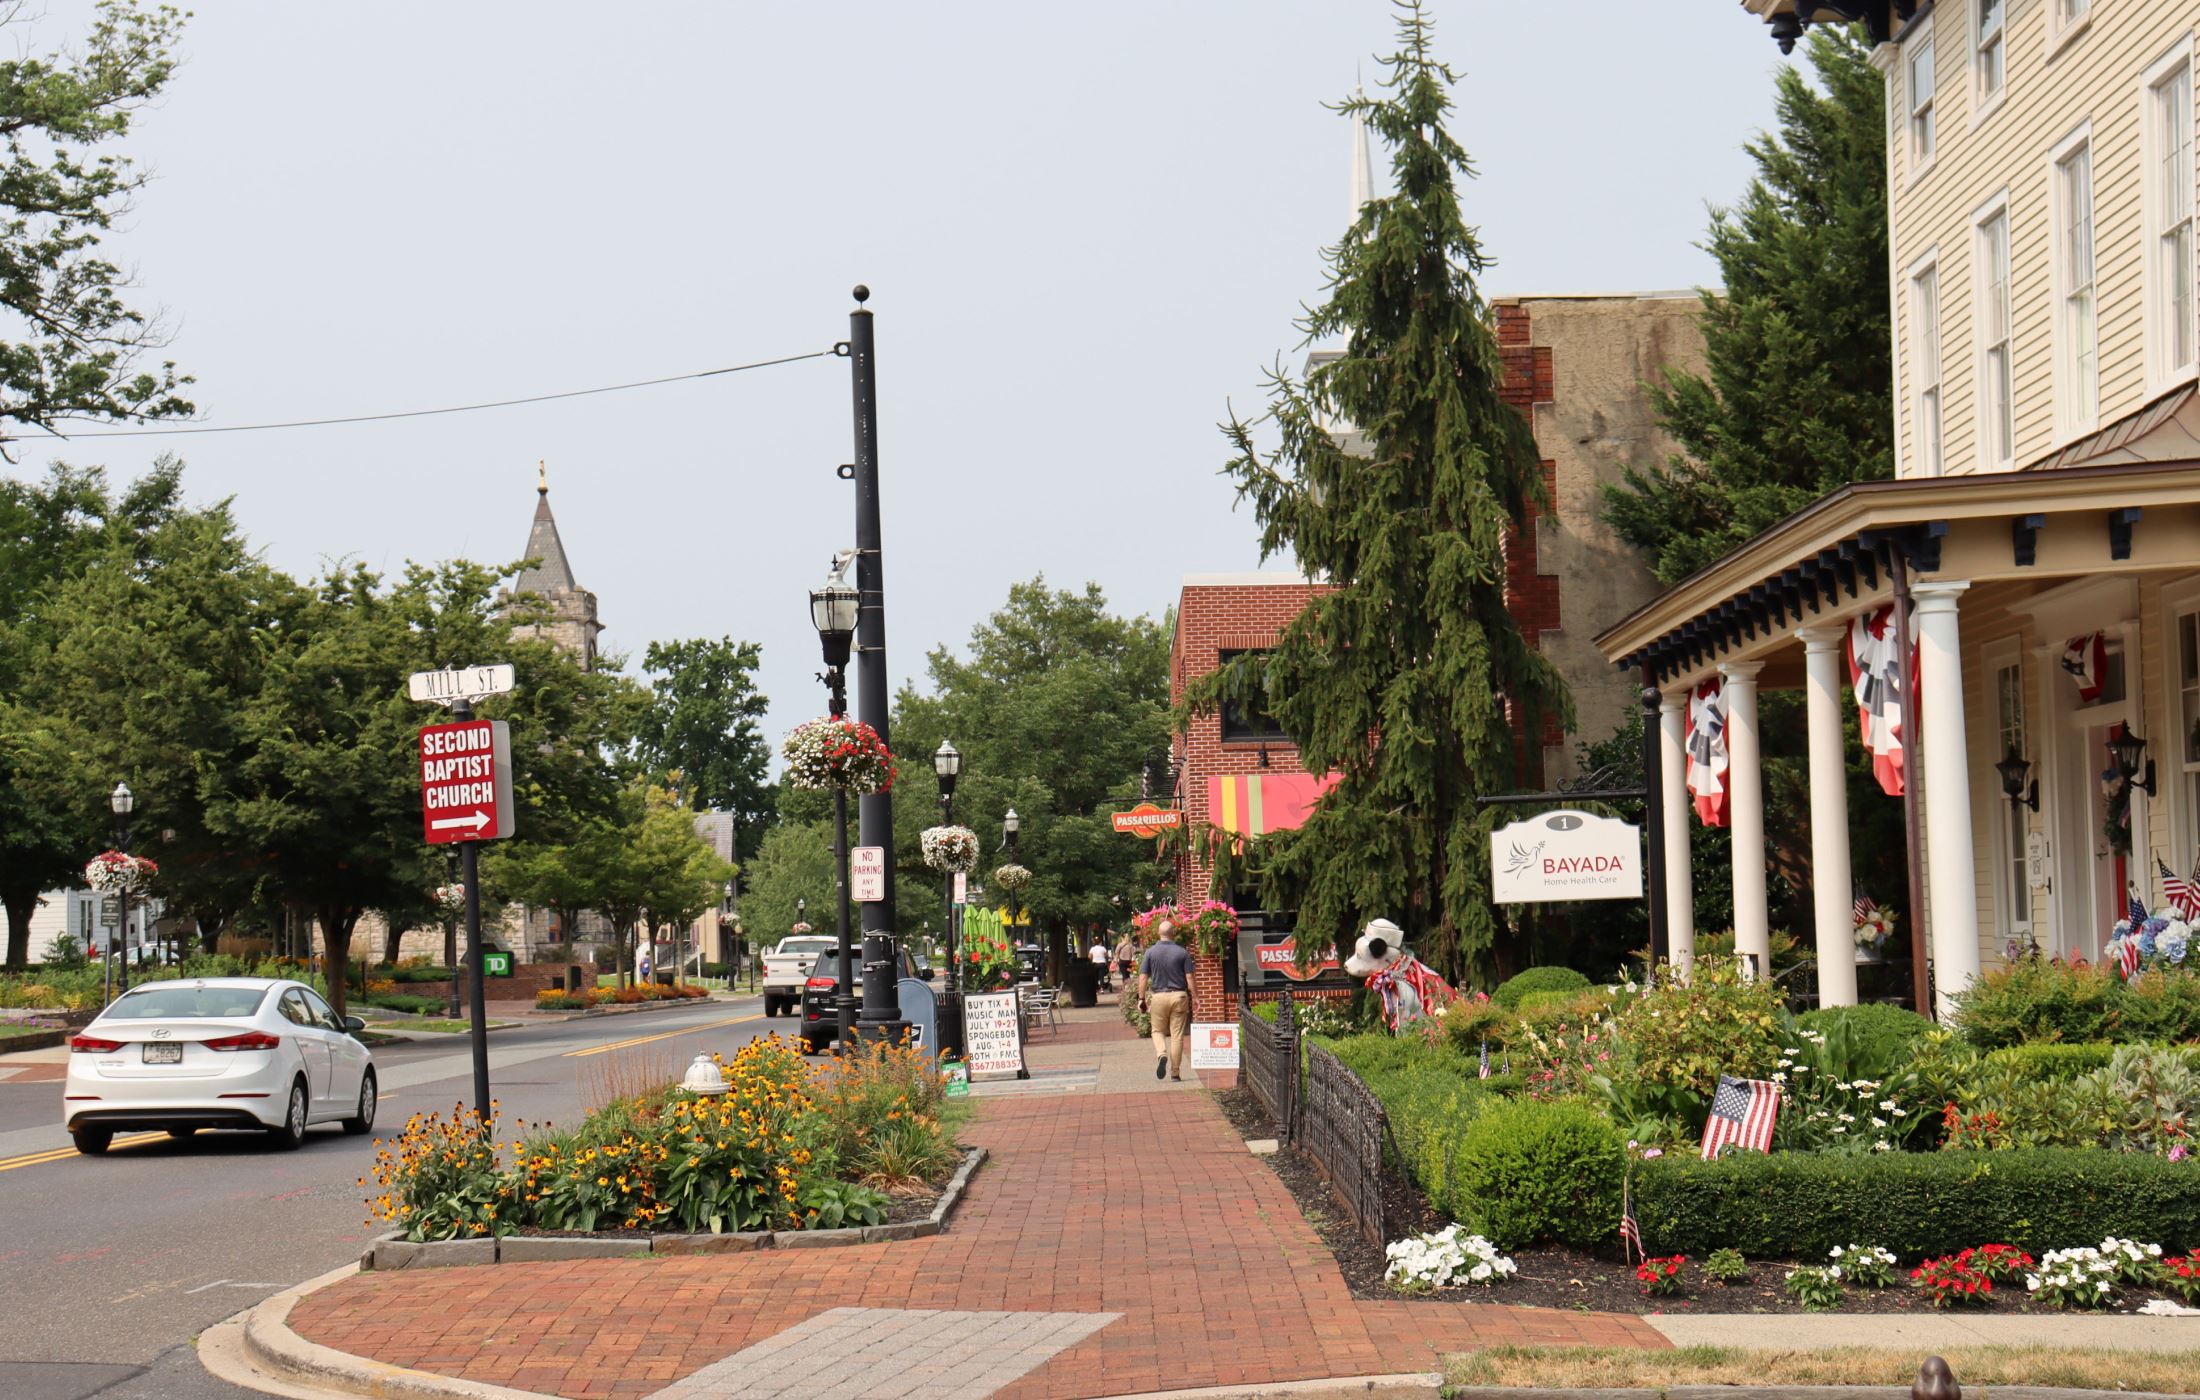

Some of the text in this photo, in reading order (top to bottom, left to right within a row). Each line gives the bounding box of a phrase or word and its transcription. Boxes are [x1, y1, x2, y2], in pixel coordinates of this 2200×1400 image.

[426, 668, 498, 696] MILL ST.
[424, 728, 490, 755] SECOND
[424, 754, 492, 783] BAPTIST
[426, 782, 494, 809] CHURCH
[1116, 812, 1176, 826] PASSARIELLO'S
[1561, 817, 1568, 829] 1
[862, 851, 873, 862] NO
[854, 864, 882, 875] PARKING
[1544, 856, 1622, 873] BAYADA
[1544, 876, 1617, 886] Home Health Care
[486, 957, 506, 971] TD
[968, 1001, 984, 1009] BUY
[988, 1000, 1000, 1008] TIX
[967, 1011, 993, 1019] MUSIC
[994, 1020, 1016, 1028] 19-27
[969, 1030, 1015, 1040] SPONGEBOB
[970, 1053, 990, 1061] BOTH
[1000, 1050, 1018, 1058] FMC
[970, 1060, 1020, 1070] 8567788357
